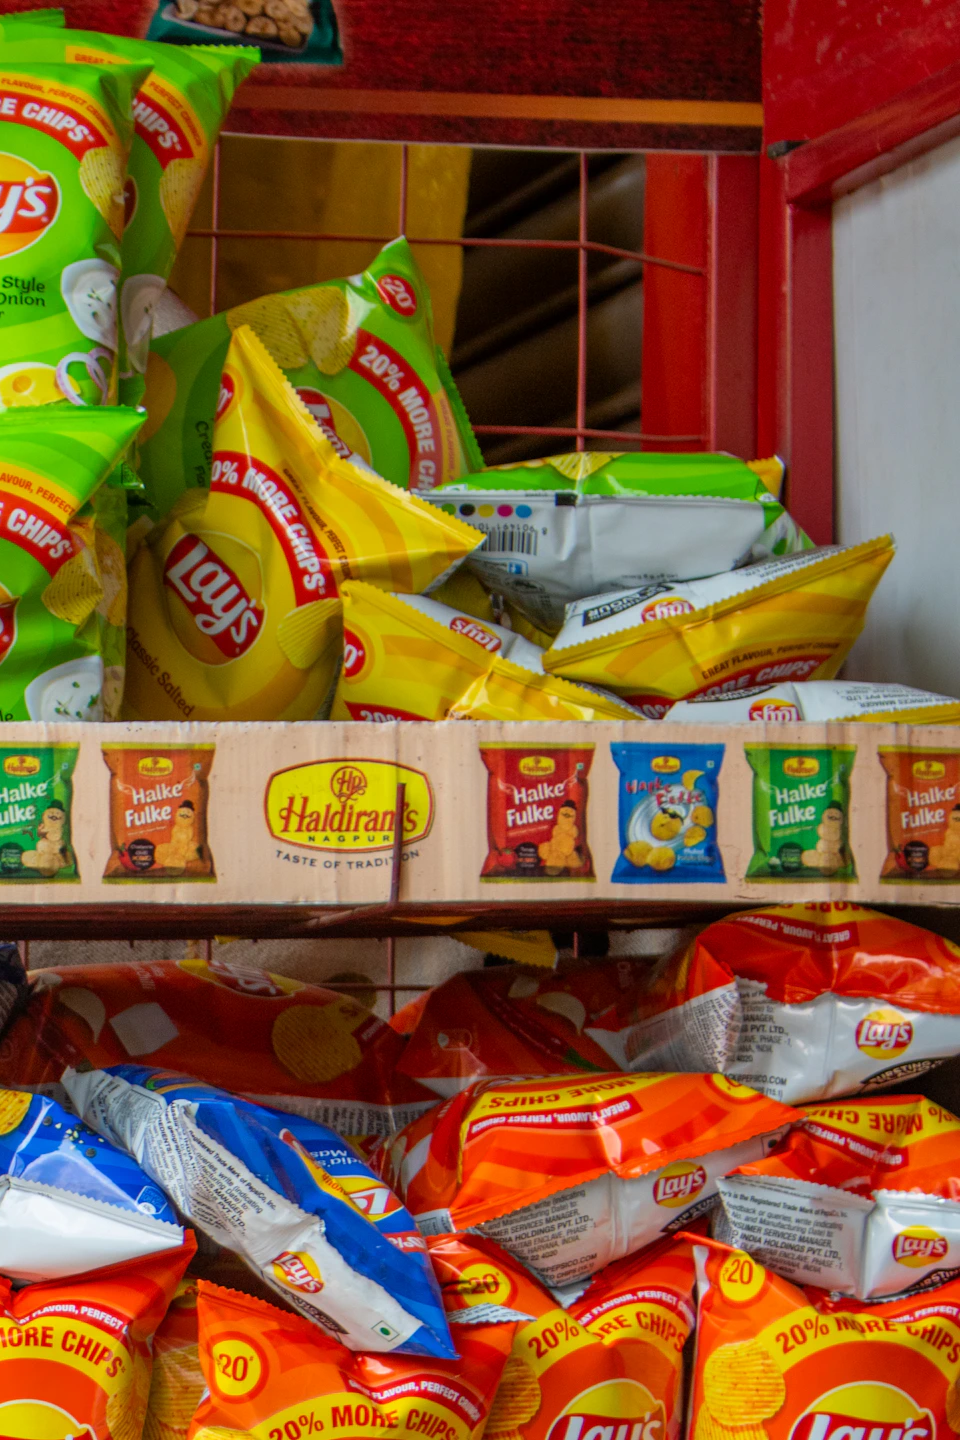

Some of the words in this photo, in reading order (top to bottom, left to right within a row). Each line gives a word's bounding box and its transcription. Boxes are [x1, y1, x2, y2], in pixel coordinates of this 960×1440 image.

[1, 276, 45, 294] Style
[242, 467, 296, 531] MORE
[169, 543, 260, 653] Lay's
[775, 783, 827, 805] Halke
[769, 805, 816, 828] Fulke
[308, 835, 391, 843] NAGPUR
[858, 1022, 910, 1049] Lay's
[740, 1233, 762, 1245] INDIA
[764, 1238, 806, 1252] HOLDINGS
[896, 1235, 946, 1257] Lay's
